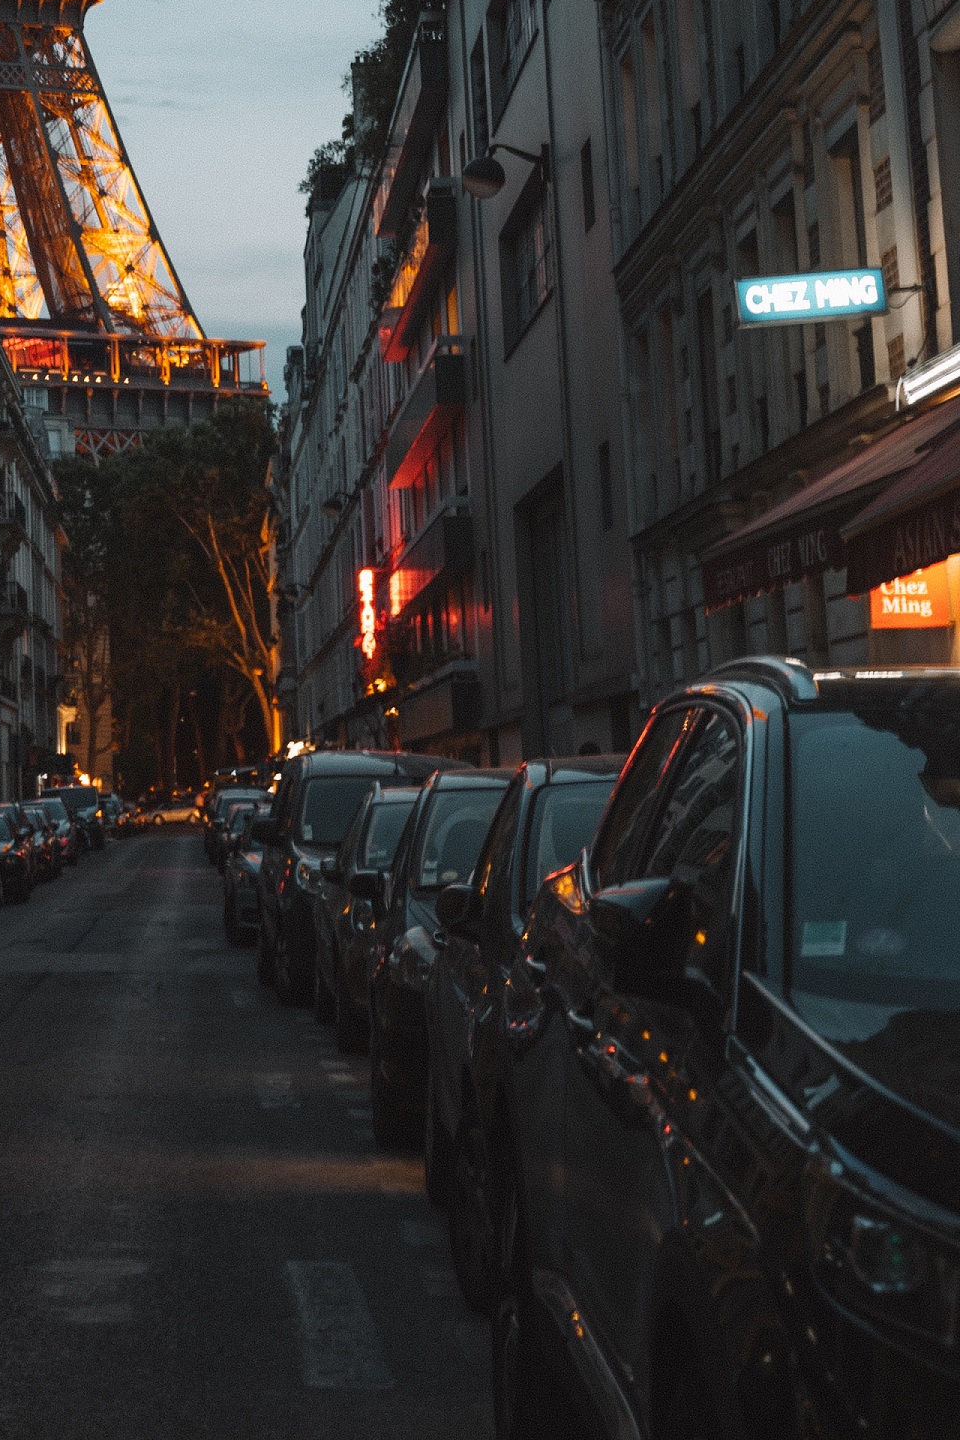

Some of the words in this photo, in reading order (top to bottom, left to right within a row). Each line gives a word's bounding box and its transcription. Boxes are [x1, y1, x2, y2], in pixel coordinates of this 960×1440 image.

[746, 281, 810, 314] CHEZ
[815, 275, 878, 308] MING
[893, 506, 945, 571] ASIAN
[768, 542, 792, 578] CHEZ
[880, 576, 928, 595] Chez
[882, 596, 933, 617] Ming
